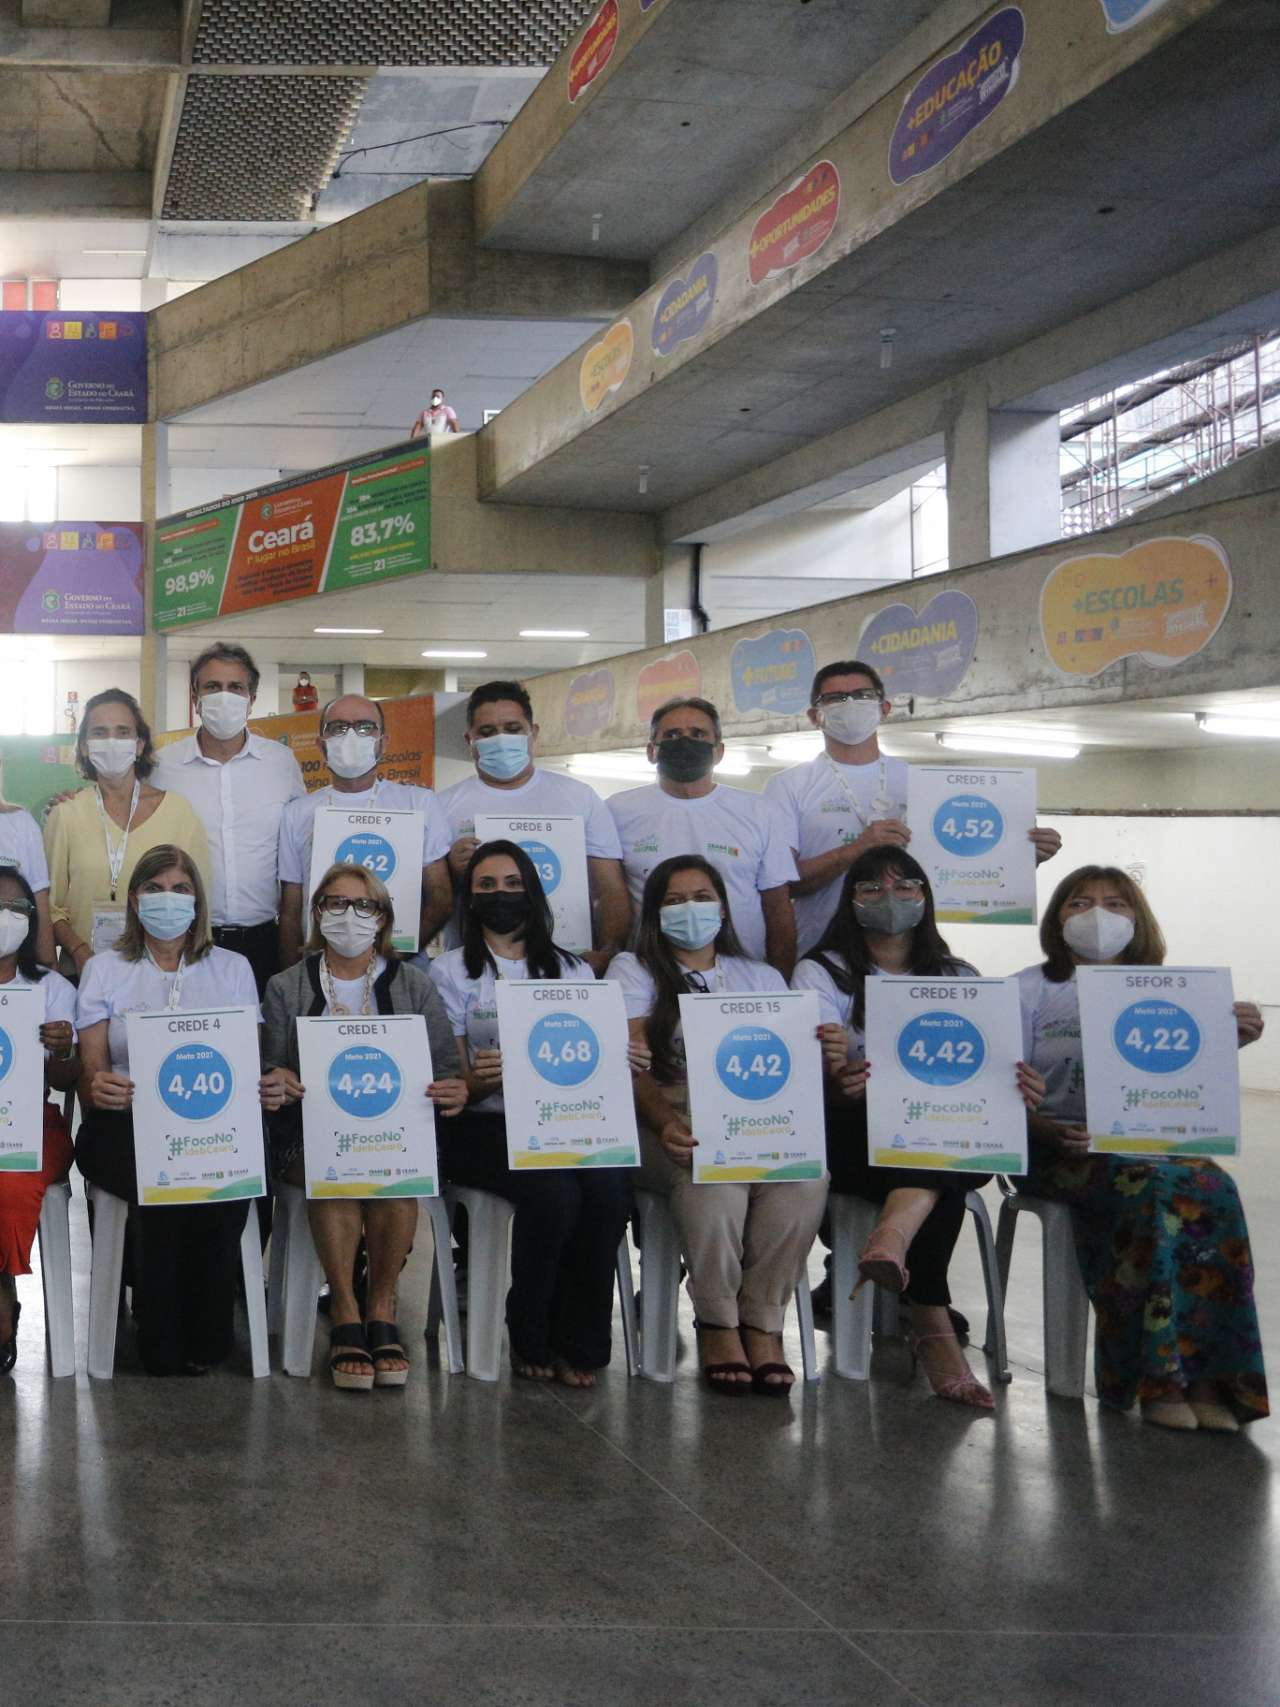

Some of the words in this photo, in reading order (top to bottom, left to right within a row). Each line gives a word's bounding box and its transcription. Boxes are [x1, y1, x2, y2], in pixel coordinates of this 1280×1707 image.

[249, 514, 313, 553] Ceará
[351, 512, 415, 546] 83,7%
[165, 567, 214, 596] 98,9%
[947, 775, 986, 784] CREDE
[991, 776, 997, 784] 3
[348, 815, 382, 824] CREDE
[509, 823, 542, 831] CREDE
[546, 823, 552, 831] 8
[942, 818, 994, 839] 4,52
[1126, 976, 1173, 987] SEFOR
[1178, 977, 1186, 987] 3
[533, 989, 572, 1000] CREDE
[577, 989, 588, 1000] 10
[910, 987, 957, 999] CREDE
[962, 988, 977, 999] 19
[720, 1003, 763, 1014] CREDE
[767, 1002, 780, 1013] 15
[168, 1019, 209, 1033] CREDE
[213, 1018, 221, 1029] 4
[338, 1025, 378, 1035] CREDE
[382, 1024, 387, 1034] 1
[1125, 1027, 1189, 1053] 4,22
[537, 1040, 591, 1066] 4,68
[908, 1040, 974, 1065] 4,42
[726, 1055, 782, 1080] 4,42
[168, 1072, 224, 1100] 4,40
[337, 1072, 393, 1098] 4,24
[1126, 1089, 1199, 1107] #FocoNo
[540, 1101, 600, 1121] #FocoNo
[907, 1102, 982, 1120] #FocoNo
[727, 1114, 790, 1135] #FocoNo
[169, 1134, 233, 1156] #FocoNo
[338, 1131, 401, 1152] #FocoNo
